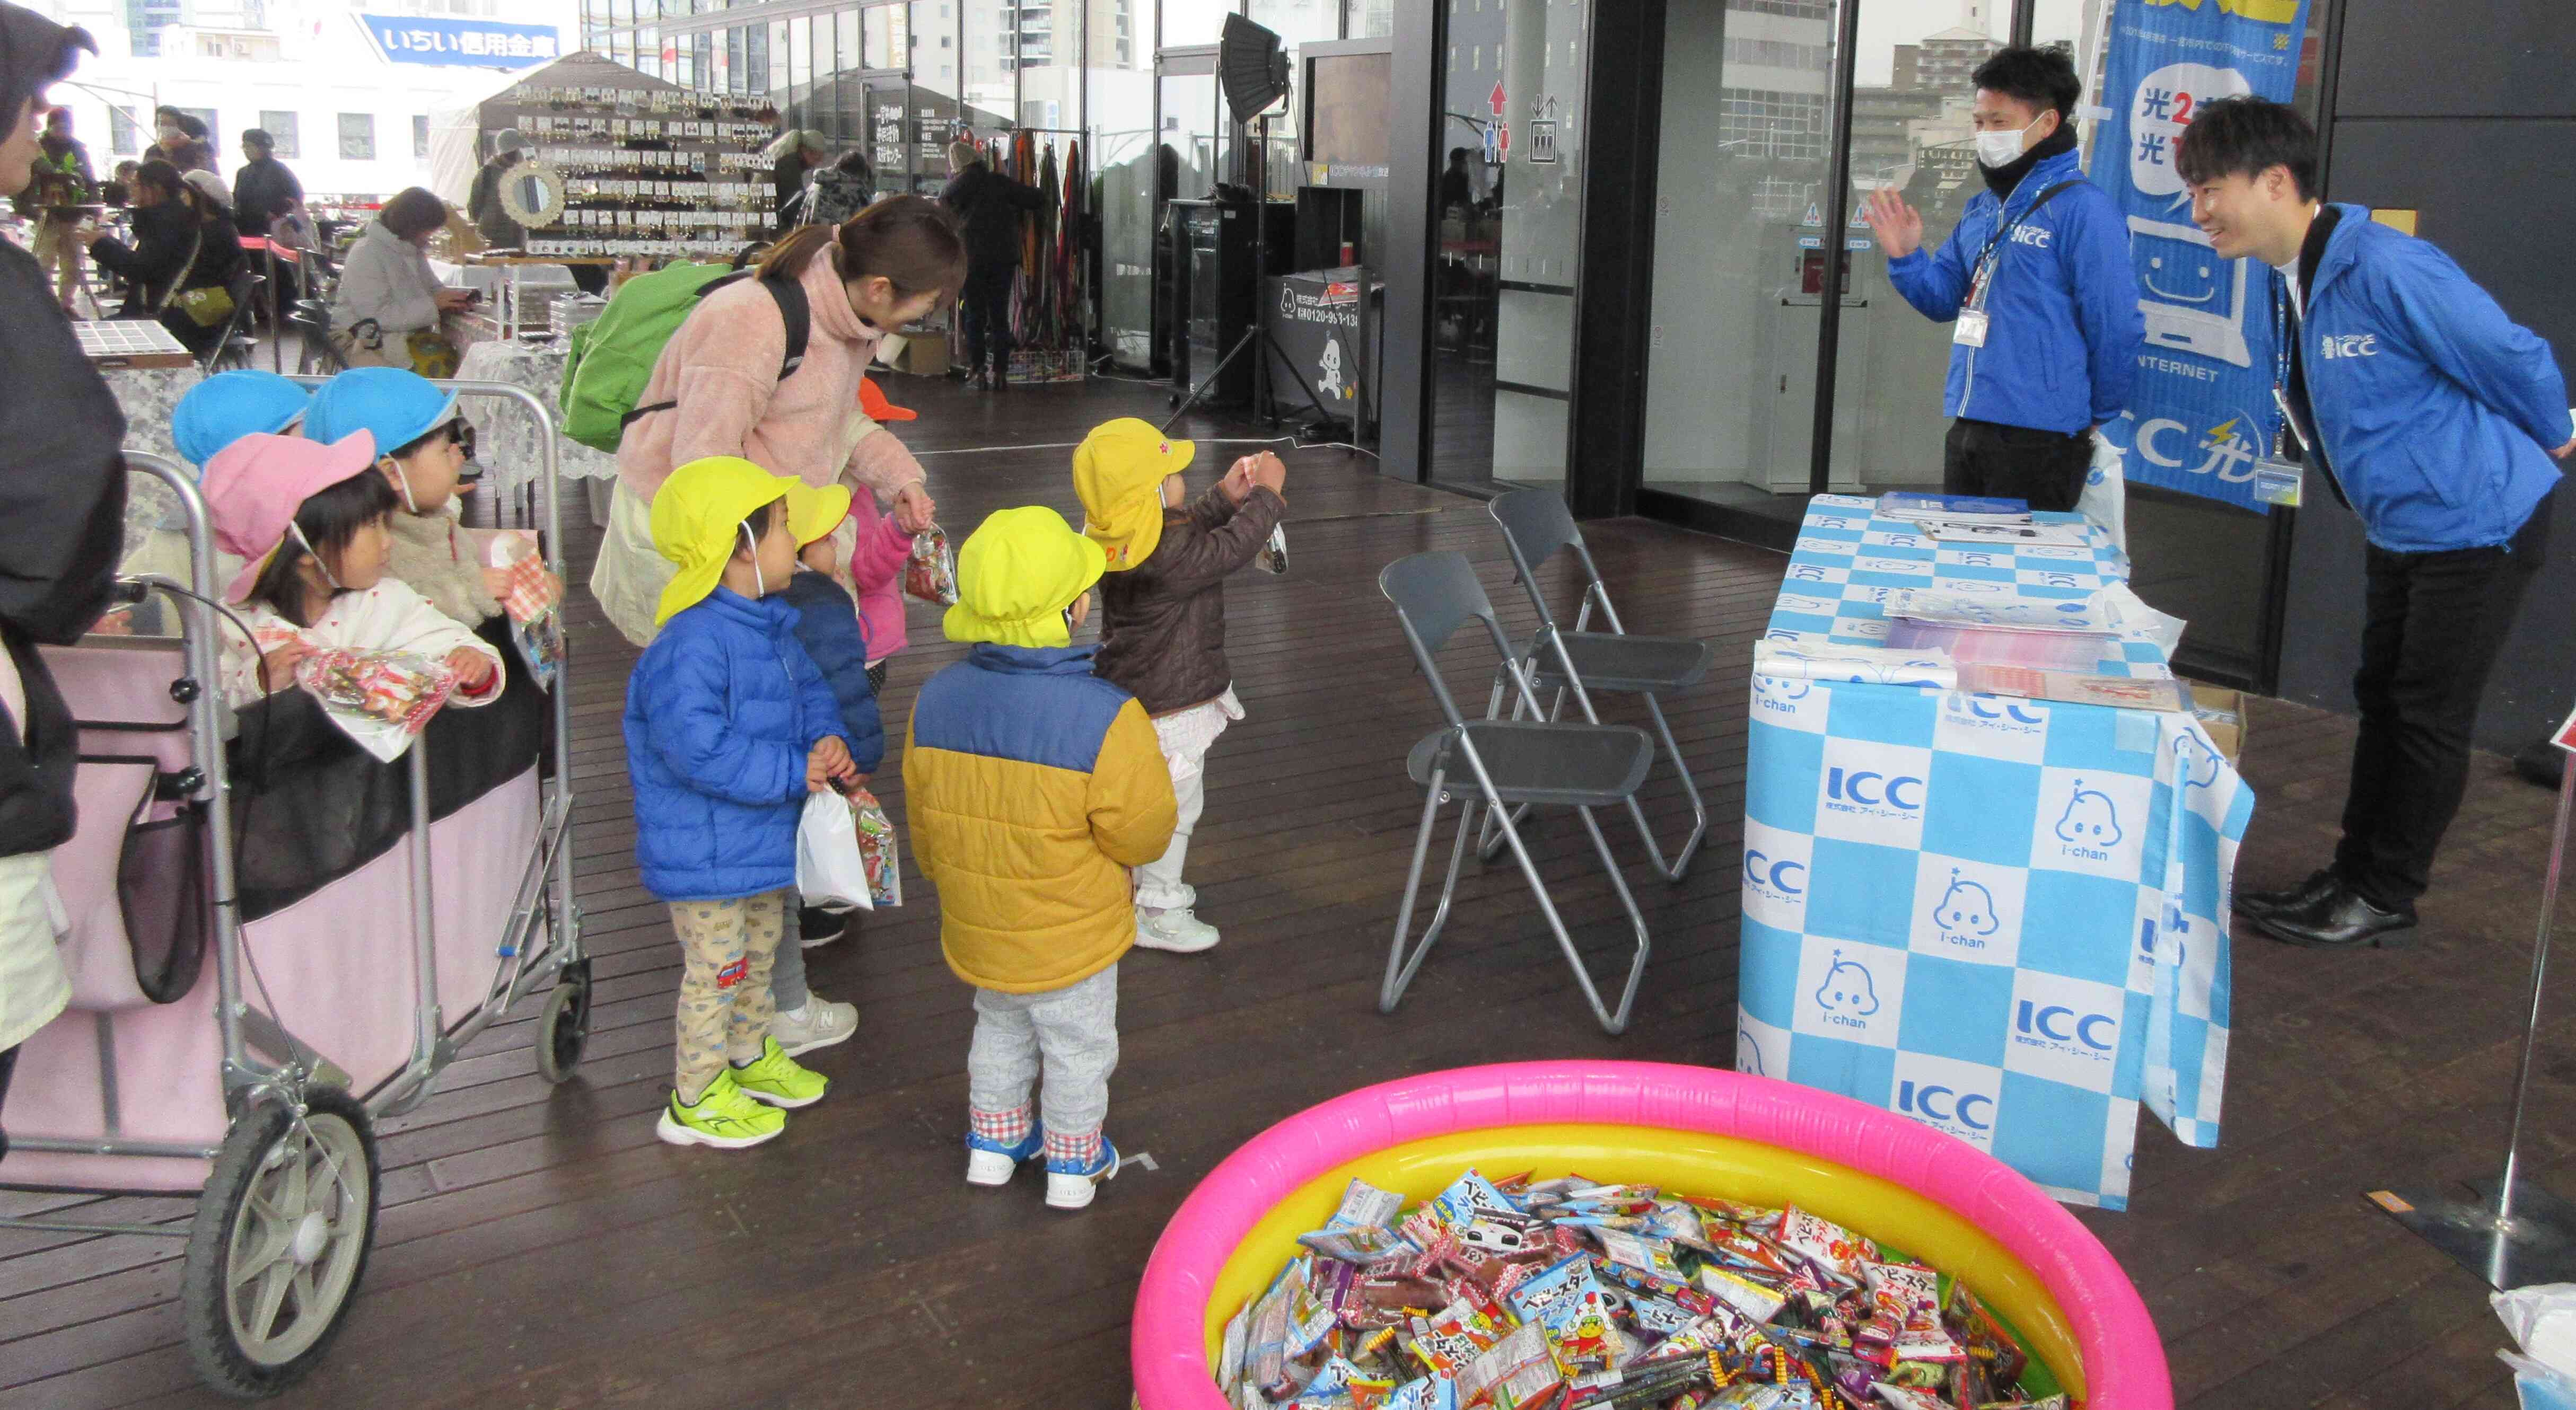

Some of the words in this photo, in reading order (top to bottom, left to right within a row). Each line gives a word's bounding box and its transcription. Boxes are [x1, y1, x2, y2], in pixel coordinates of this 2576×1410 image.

[384, 29, 555, 58] いちい信用金庫
[2336, 340, 2379, 358] ICC
[2137, 354, 2219, 383] NTERNET
[1755, 696, 1796, 714] i-chan
[1827, 766, 1922, 809] ICC
[1825, 801, 1856, 813] 株式会社
[1860, 806, 1918, 819] アイ・シー・シー
[2061, 844, 2108, 861] i-chan
[1745, 849, 1804, 894] CC
[1940, 932, 1986, 949] i-chan
[1823, 1012, 1867, 1029] i-chan
[2017, 999, 2115, 1051] ICC
[1899, 1080, 1993, 1130] ICC
[1522, 1274, 1589, 1309] ベビースター
[1870, 1265, 1935, 1292] ベビースター
[1538, 1291, 1581, 1321] ラーメン
